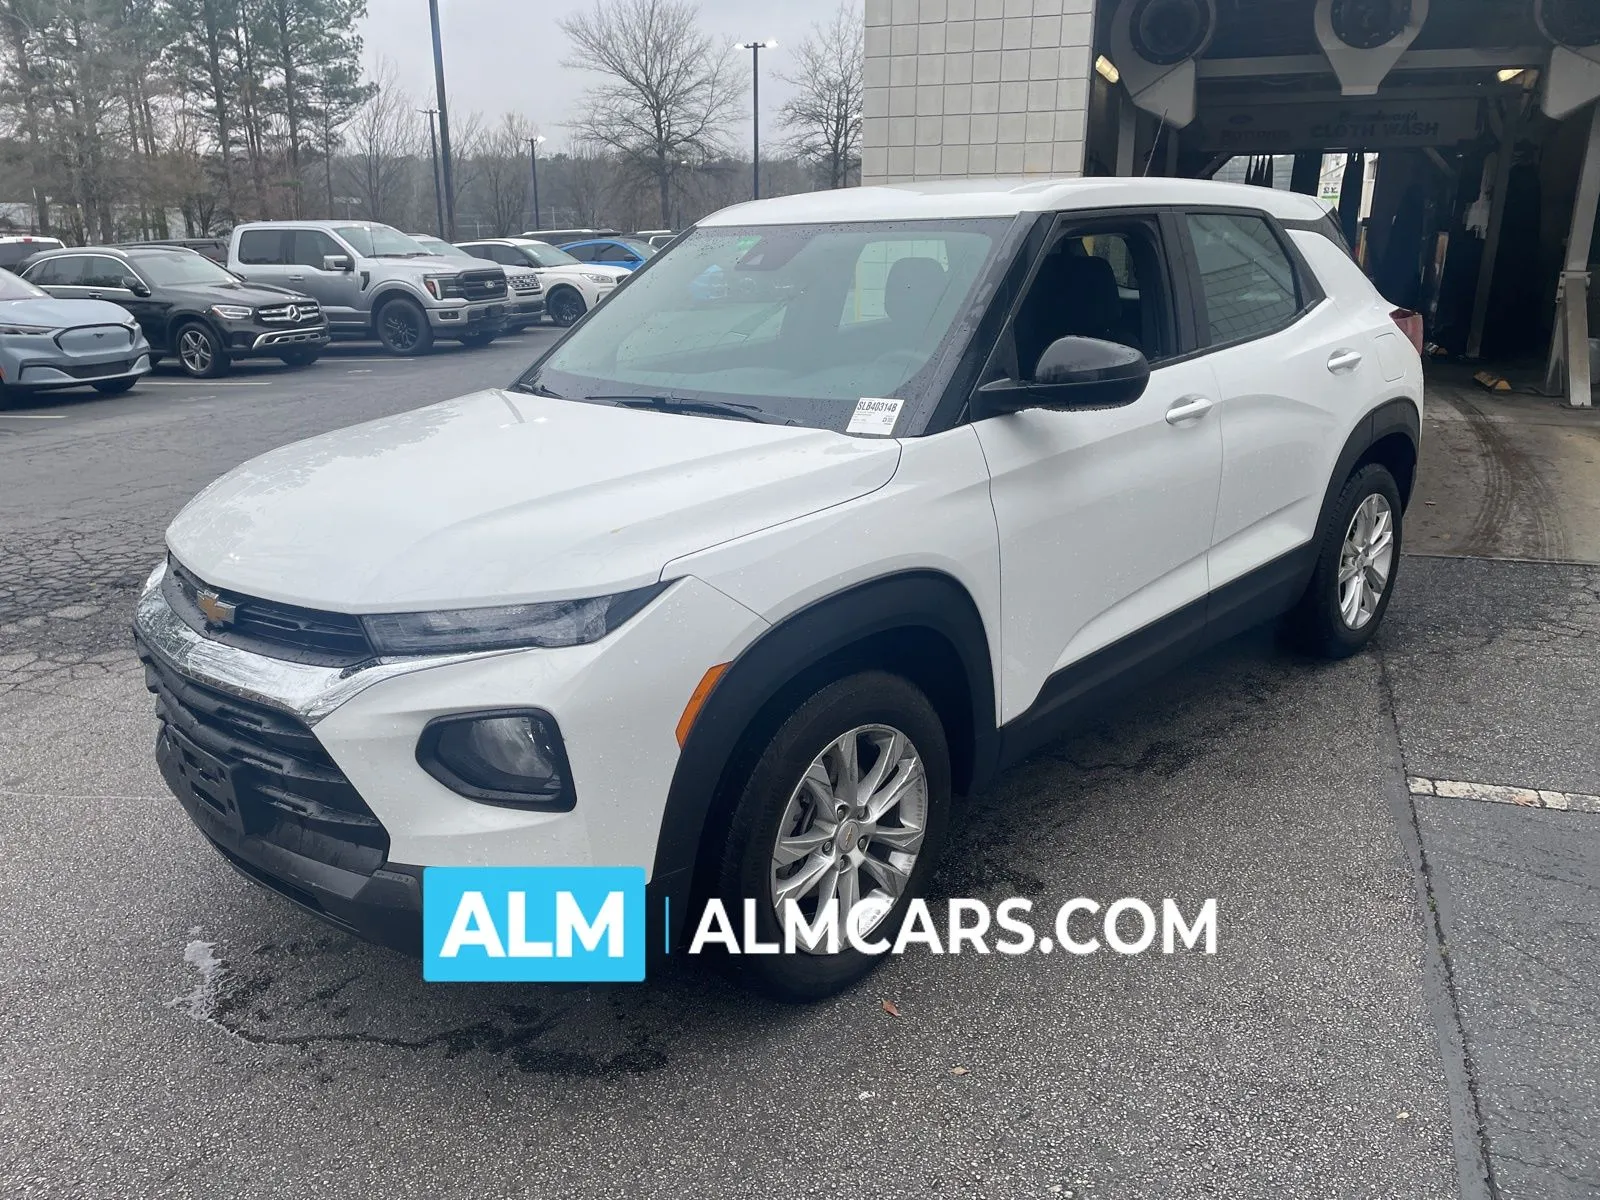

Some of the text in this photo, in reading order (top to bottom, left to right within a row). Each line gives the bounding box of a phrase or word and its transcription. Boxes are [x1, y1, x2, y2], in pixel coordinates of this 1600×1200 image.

[1311, 121, 1440, 138] CLOTH WASH
[857, 401, 897, 412] SLB40314B
